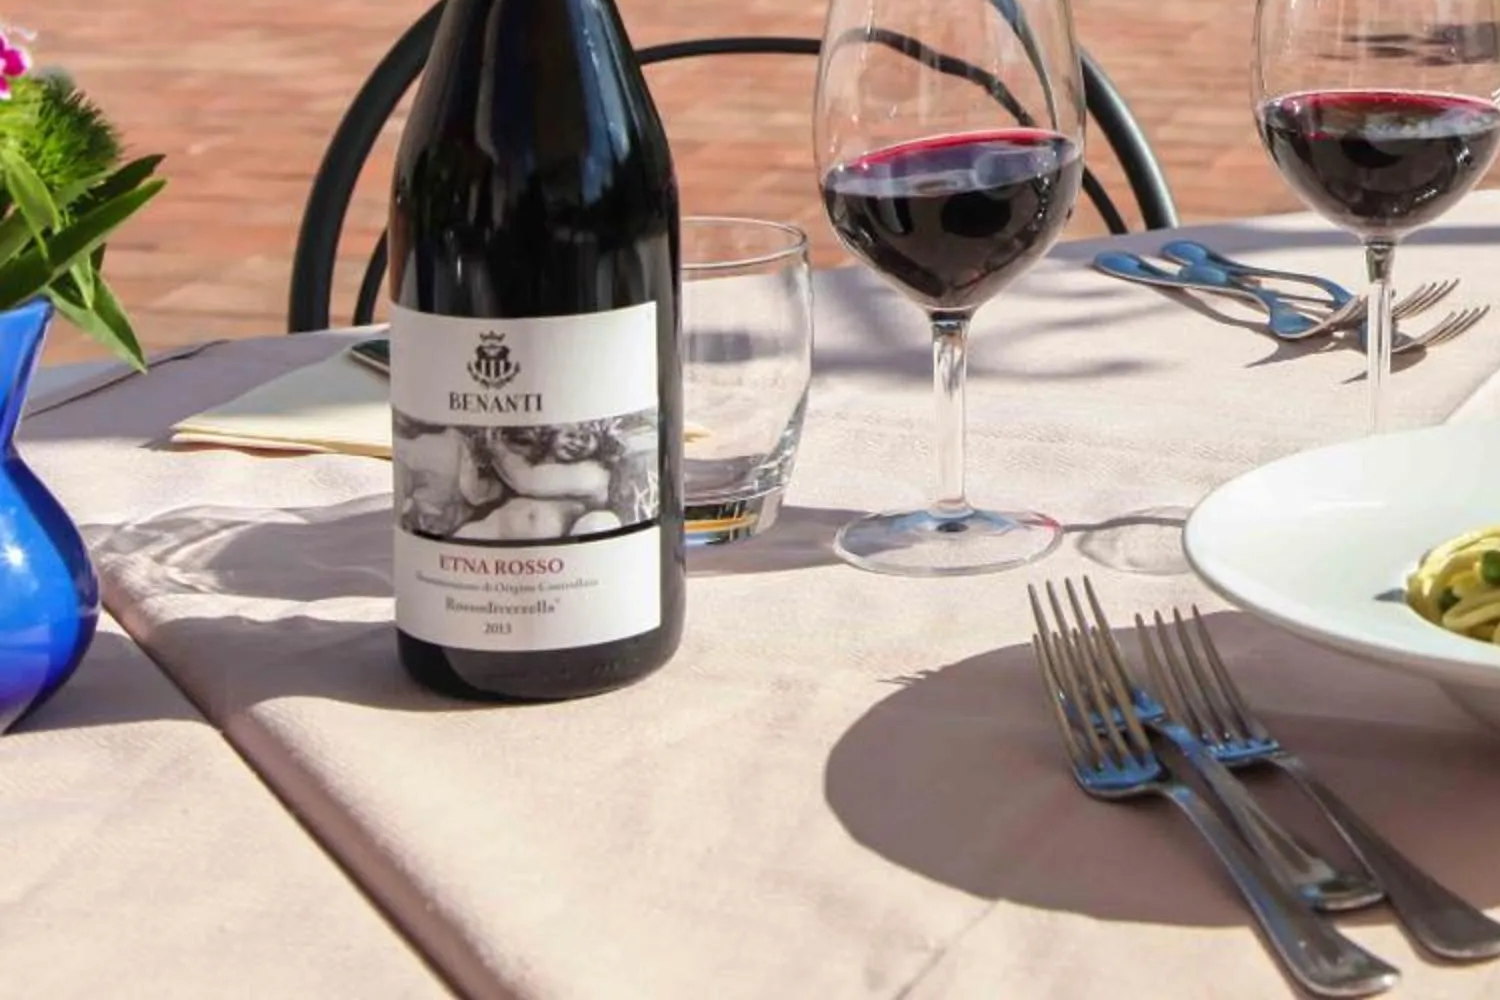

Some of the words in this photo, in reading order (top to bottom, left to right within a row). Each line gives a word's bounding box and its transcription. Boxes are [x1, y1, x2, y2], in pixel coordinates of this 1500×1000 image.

[449, 391, 543, 413] BENANTI
[439, 554, 491, 575] ETNA
[495, 557, 564, 576] ROSSO
